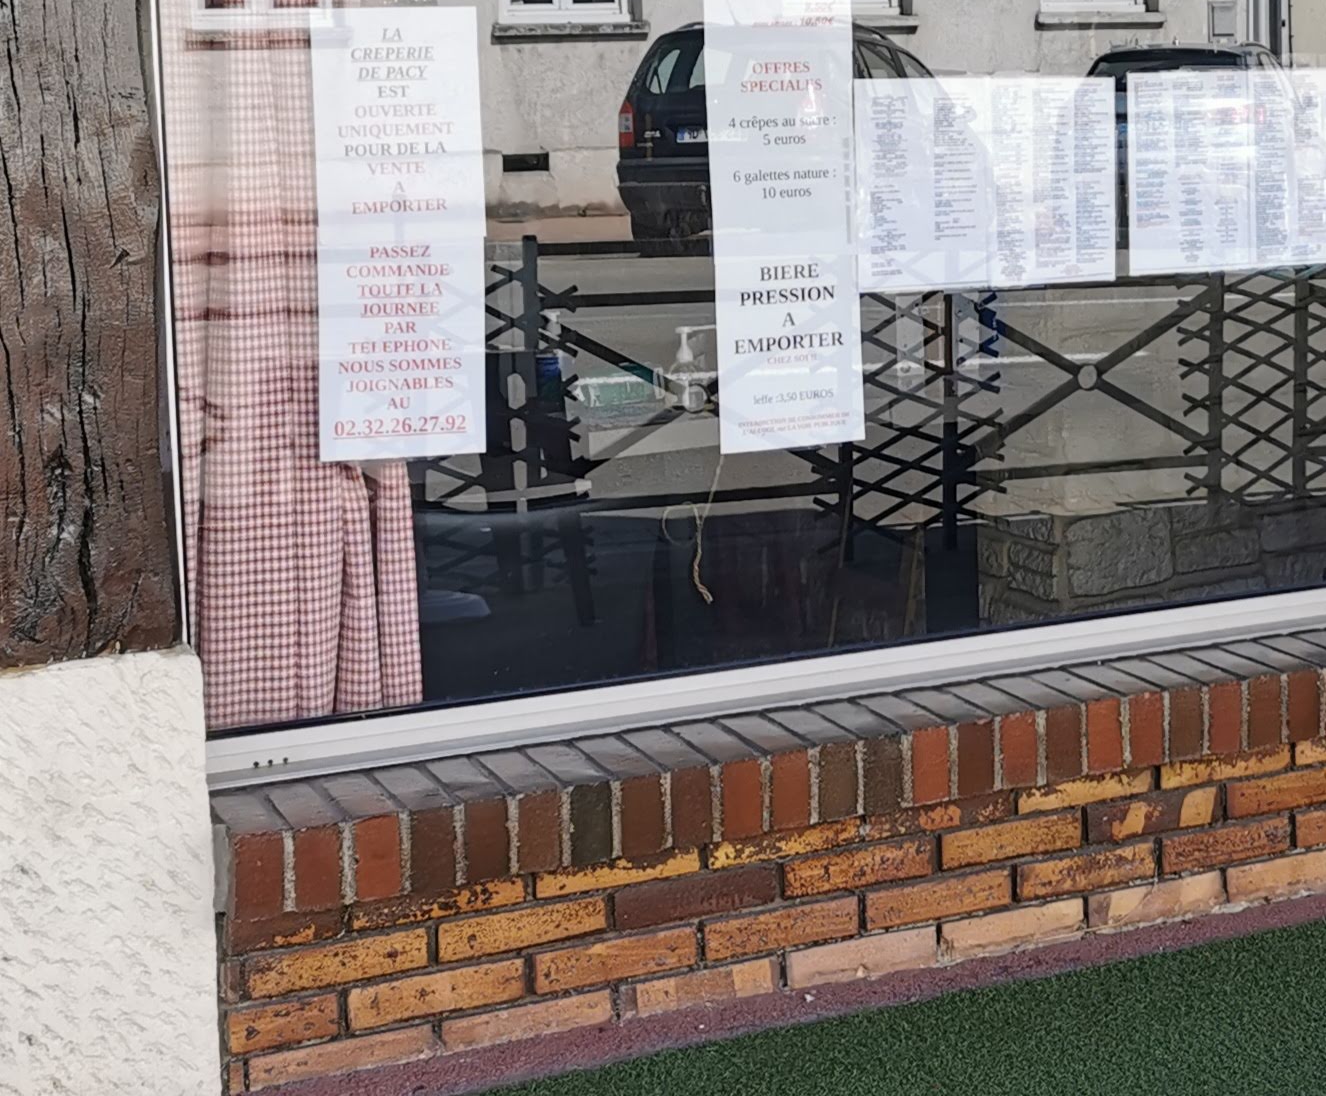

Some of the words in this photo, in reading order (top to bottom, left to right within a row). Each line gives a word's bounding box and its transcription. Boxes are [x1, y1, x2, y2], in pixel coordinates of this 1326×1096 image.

[381, 27, 404, 42] LA
[350, 46, 436, 62] CREPERIE
[357, 66, 381, 81] DE
[386, 65, 428, 80] PACY
[752, 61, 811, 75] OFFRES
[377, 85, 410, 98] EST
[740, 79, 823, 93] SPECIALES
[354, 103, 437, 119] OUVERTE
[337, 121, 454, 139] UNIQUEMENT
[728, 118, 736, 128] 4
[740, 115, 779, 130] crêpes
[782, 118, 796, 127] au
[763, 134, 771, 145] 5
[775, 134, 806, 145] euros
[344, 143, 392, 157] POUR
[397, 142, 420, 156] DE
[424, 141, 448, 155] LA
[367, 161, 426, 176] VENTE
[733, 171, 741, 182] 6
[744, 169, 791, 184] galettes
[794, 169, 829, 180] nature
[392, 181, 406, 194] A
[762, 188, 776, 199] 10
[780, 187, 812, 198] euros
[351, 198, 448, 215] EMPORTER
[369, 245, 431, 258] PASSEZ
[346, 263, 450, 279] COMMANDE
[760, 264, 820, 282] BIERE
[357, 284, 415, 299] TOUTE
[419, 282, 443, 297] LA
[740, 285, 836, 307] PRESSION
[361, 301, 440, 318] JOURNEE
[782, 311, 796, 327] A
[384, 321, 417, 334] PAR
[347, 338, 452, 354] TELEPHONE
[734, 331, 844, 355] EMPORTER
[338, 360, 385, 374] NOUS
[388, 357, 462, 372] SOMMES
[346, 376, 454, 393] JOIGNABLES
[799, 388, 834, 401] EUROS
[386, 396, 411, 410] AU
[333, 415, 467, 440] 02.32.26.27.92
